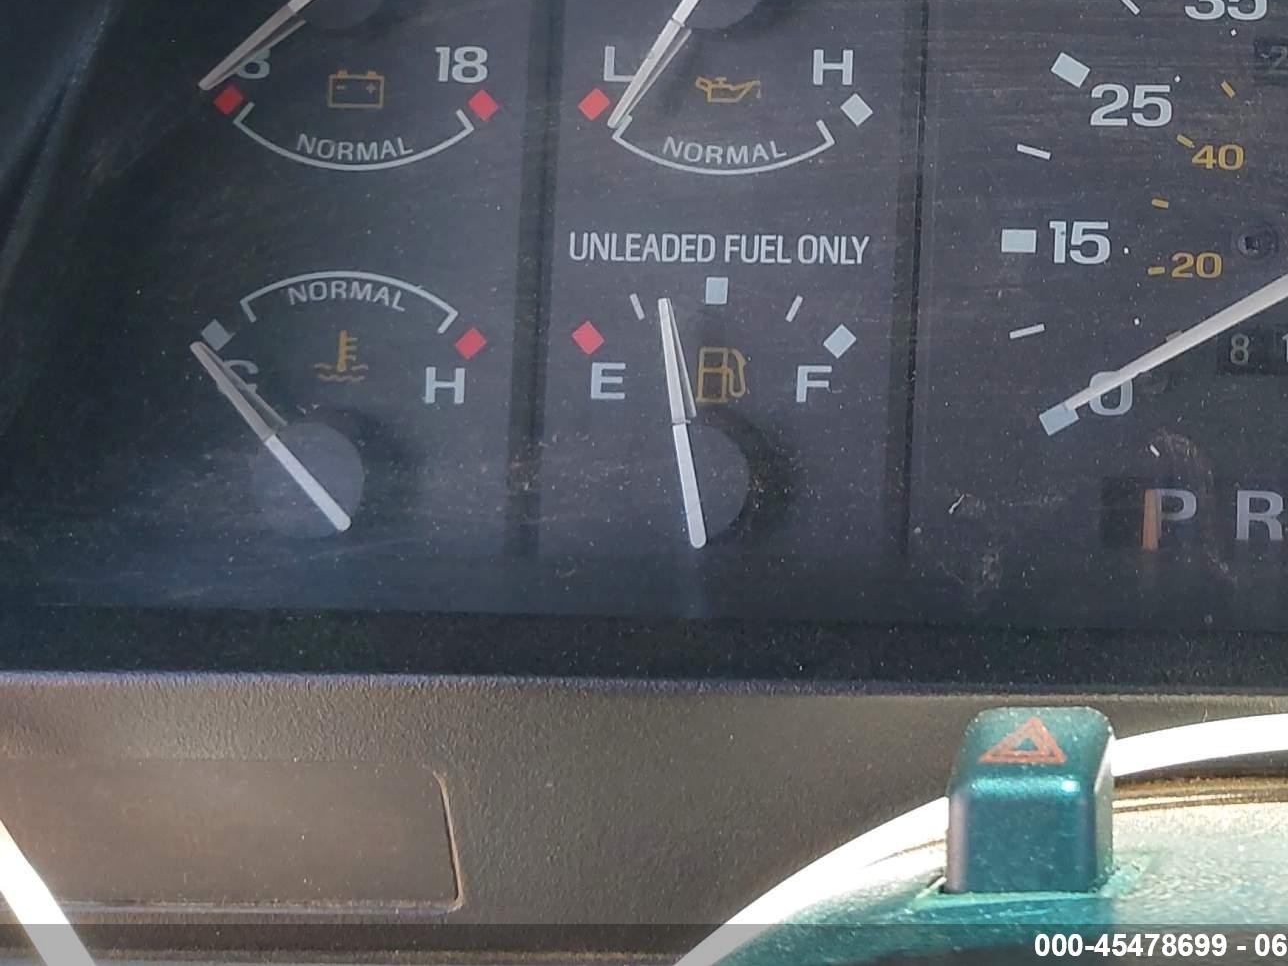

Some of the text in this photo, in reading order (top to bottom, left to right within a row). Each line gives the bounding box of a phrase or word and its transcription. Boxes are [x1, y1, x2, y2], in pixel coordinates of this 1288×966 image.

[435, 46, 488, 83] 18
[604, 46, 636, 83] L
[813, 49, 853, 85] H
[1090, 84, 1172, 127] 25
[296, 134, 413, 161] NORMAL
[662, 136, 787, 164] NORMAL
[1191, 144, 1245, 170] 40
[569, 232, 870, 264] UNLEADED FUEL ONLY
[1050, 221, 1110, 264] 15
[1171, 252, 1223, 278] 20
[288, 280, 405, 311] NORMAL
[425, 367, 465, 404] H
[591, 362, 626, 400] E
[796, 365, 832, 402] F
[1089, 371, 1133, 416] 0
